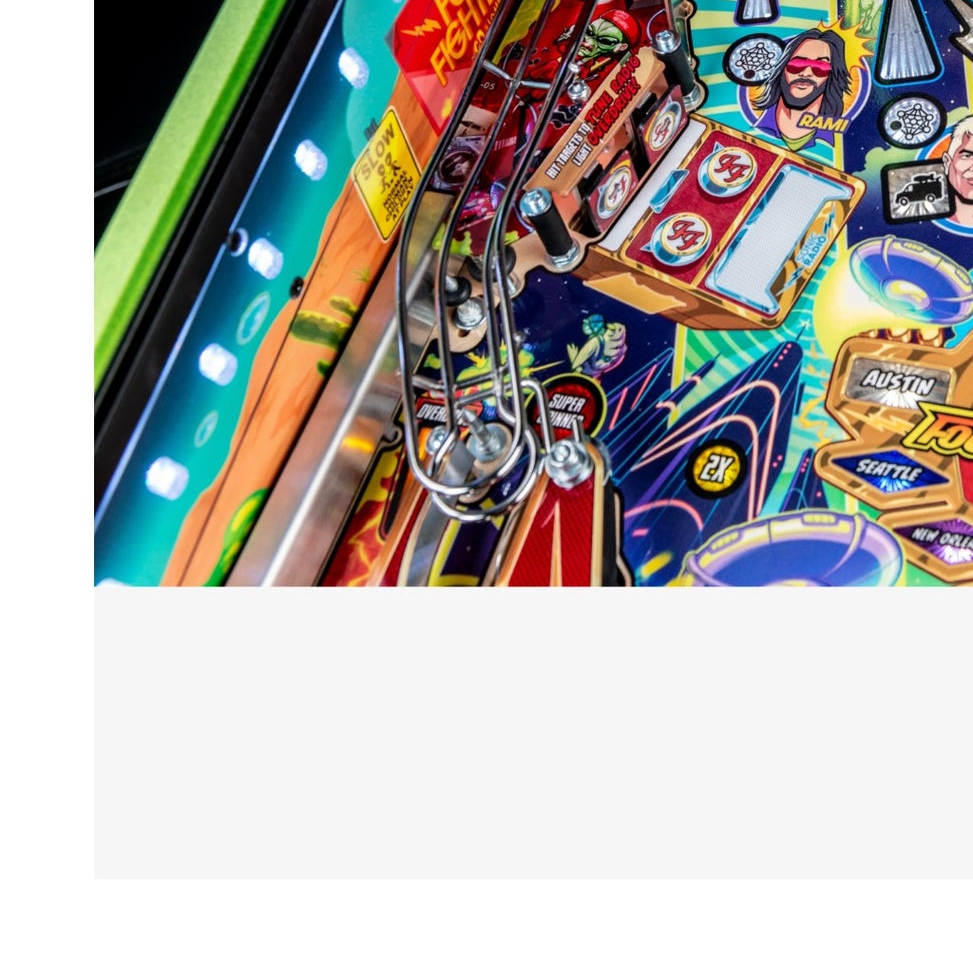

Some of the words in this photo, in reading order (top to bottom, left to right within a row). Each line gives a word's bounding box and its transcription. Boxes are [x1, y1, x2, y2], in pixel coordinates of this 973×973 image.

[545, 160, 562, 180] HIT
[557, 135, 584, 166] TARGETS
[578, 122, 591, 137] TO
[585, 90, 614, 125] TUNE
[610, 55, 641, 94] RADIO
[571, 143, 593, 167] LIGHT
[587, 76, 641, 146] OVERDRIVE!
[799, 112, 850, 132] RAMI
[360, 123, 396, 181] SLOW
[383, 169, 406, 208] NORMAL
[385, 176, 413, 222] CHILDREN
[386, 176, 408, 211] HUMAN
[400, 184, 413, 207] PLAY
[795, 232, 816, 261] SONIC
[803, 235, 827, 266] RADIO
[860, 369, 937, 397] AUSTIN
[549, 393, 587, 413] SUPER
[699, 454, 735, 483] 2X
[856, 458, 923, 482] SEATTLE
[911, 526, 937, 545] NEW
